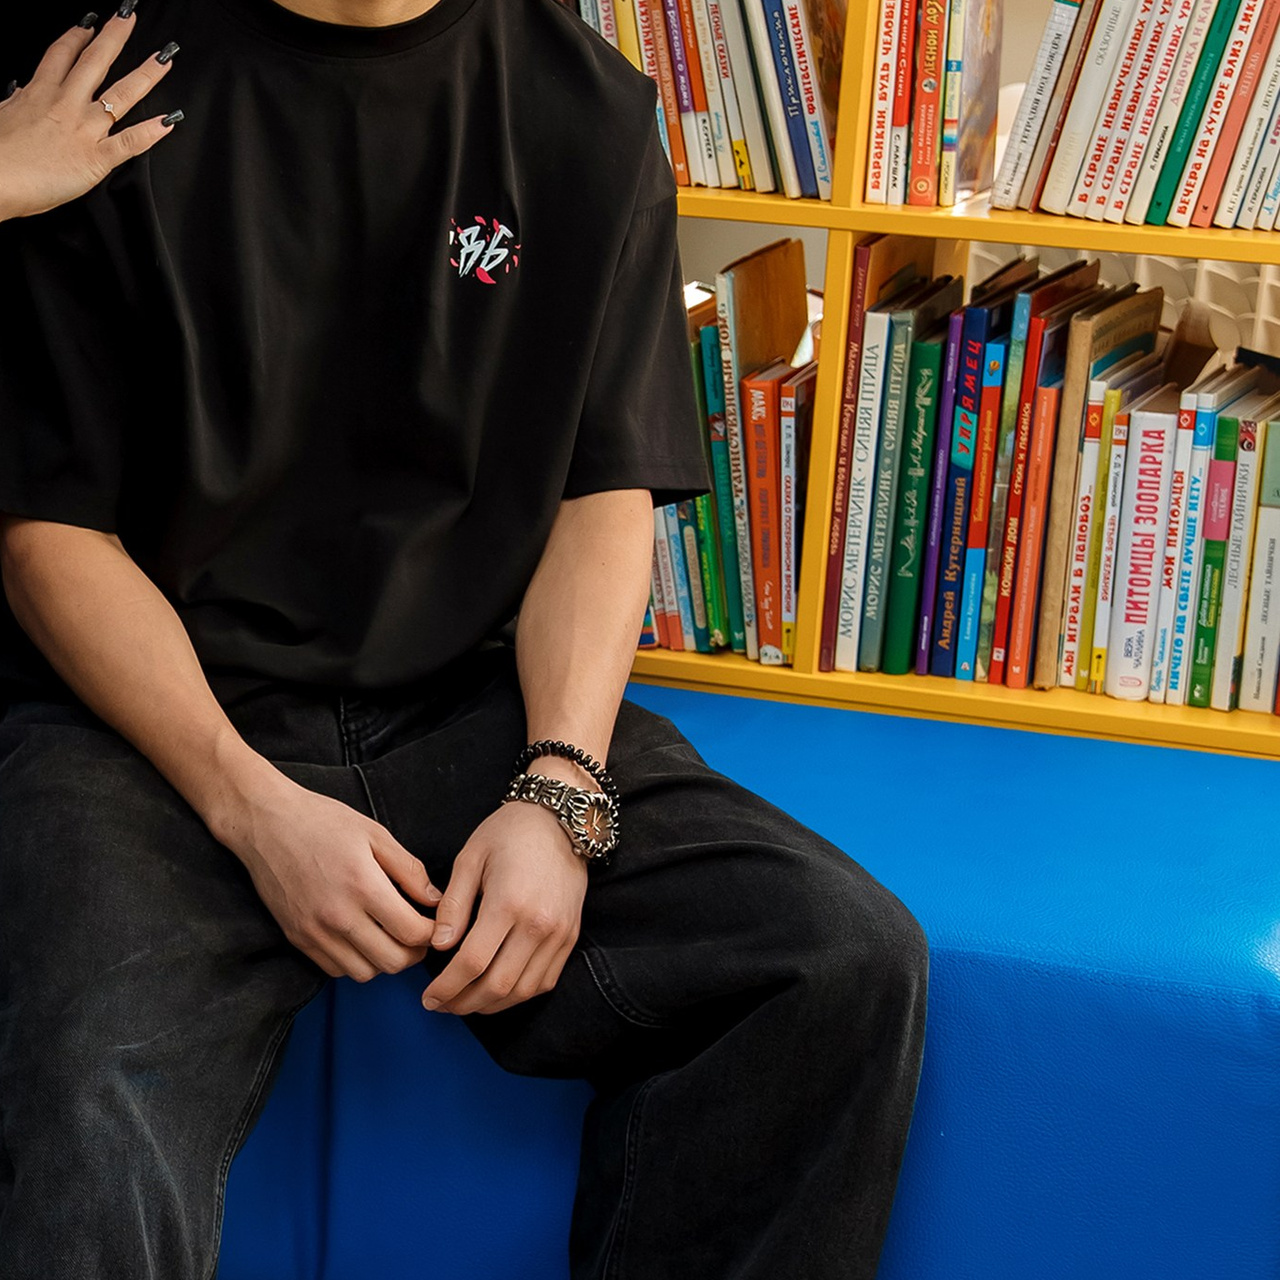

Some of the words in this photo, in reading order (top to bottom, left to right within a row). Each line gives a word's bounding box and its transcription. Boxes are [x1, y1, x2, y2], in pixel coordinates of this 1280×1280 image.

[878, 63, 891, 101] БУДЬ
[924, 30, 940, 76] ЛЕСНОЙ
[1203, 82, 1230, 135] ХУТОРЕ
[1222, 39, 1245, 77] БЛИЗ
[1077, 194, 1091, 202] В
[1100, 19, 1147, 129] НЕВЫУЧЕННЫХ
[859, 344, 879, 402] ПТИЦА
[959, 341, 981, 454] УПРЯМЕЦ
[854, 407, 873, 463] СИНЯЯ
[1135, 430, 1165, 525] ЗООПАРКА
[844, 477, 867, 575] МЕТЕРЛИНК
[945, 478, 966, 581] Кутерницкий
[839, 579, 858, 637] МОРИС
[1126, 532, 1155, 624] ПИТОМЦЫ
[938, 591, 956, 650] Андрей
[1124, 637, 1134, 658] ВЕРА
[1134, 630, 1146, 669] ЧАПЛИНА
